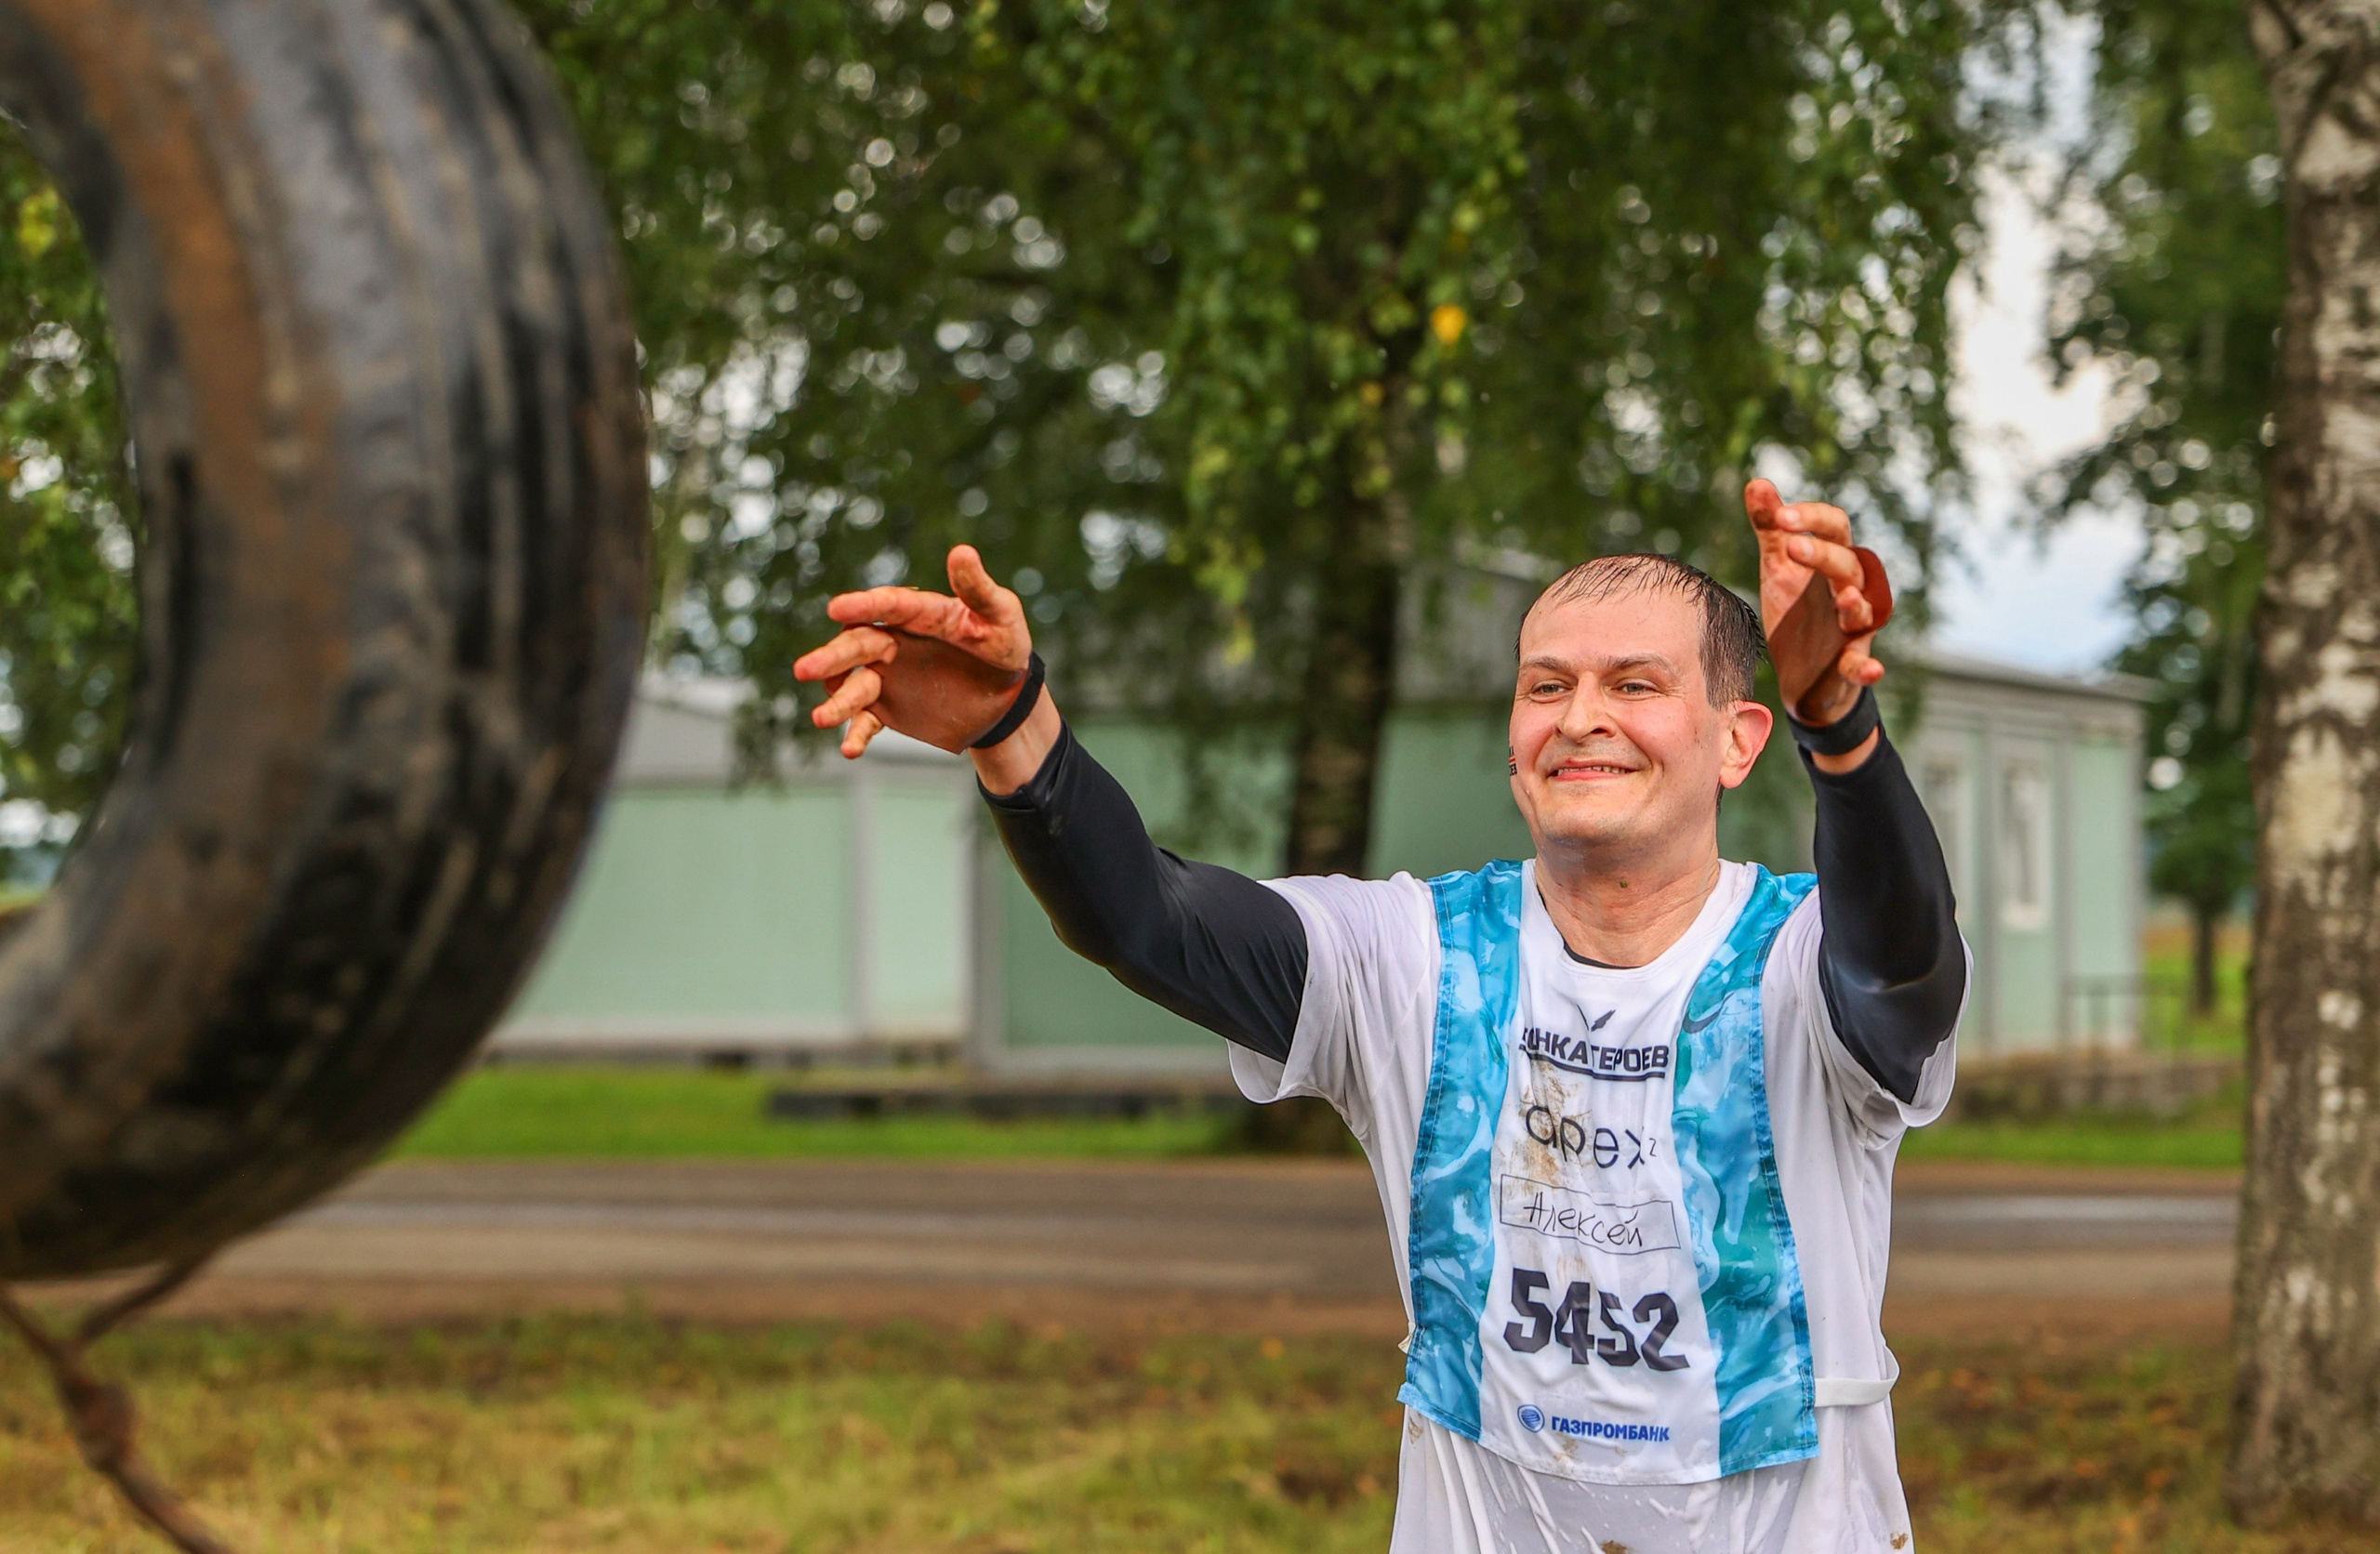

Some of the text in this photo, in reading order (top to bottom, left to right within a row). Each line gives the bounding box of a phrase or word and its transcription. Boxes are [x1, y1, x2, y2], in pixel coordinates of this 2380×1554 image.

[1523, 1192, 1643, 1247] Алексей
[1503, 1268, 1690, 1371] 5452
[1552, 1416, 1670, 1442] ГАЗПРОМБАНК
